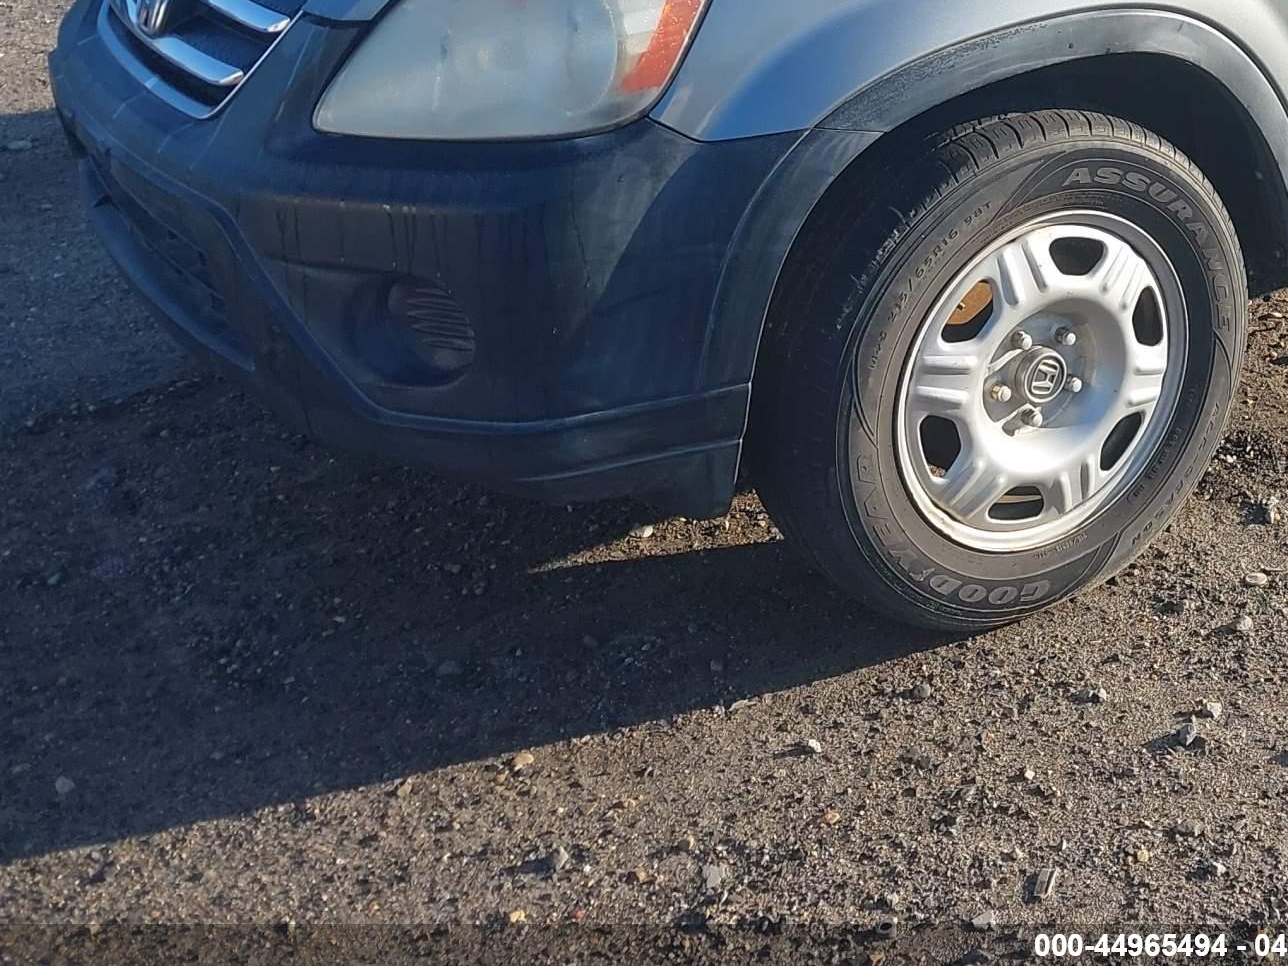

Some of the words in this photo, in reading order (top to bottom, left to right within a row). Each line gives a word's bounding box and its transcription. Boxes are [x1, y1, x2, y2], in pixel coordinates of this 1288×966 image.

[888, 228, 960, 323] 215/65R16
[963, 201, 993, 226] 98T
[1063, 167, 1232, 332] ASSURANCE
[855, 452, 1050, 605] GOODYEAR
